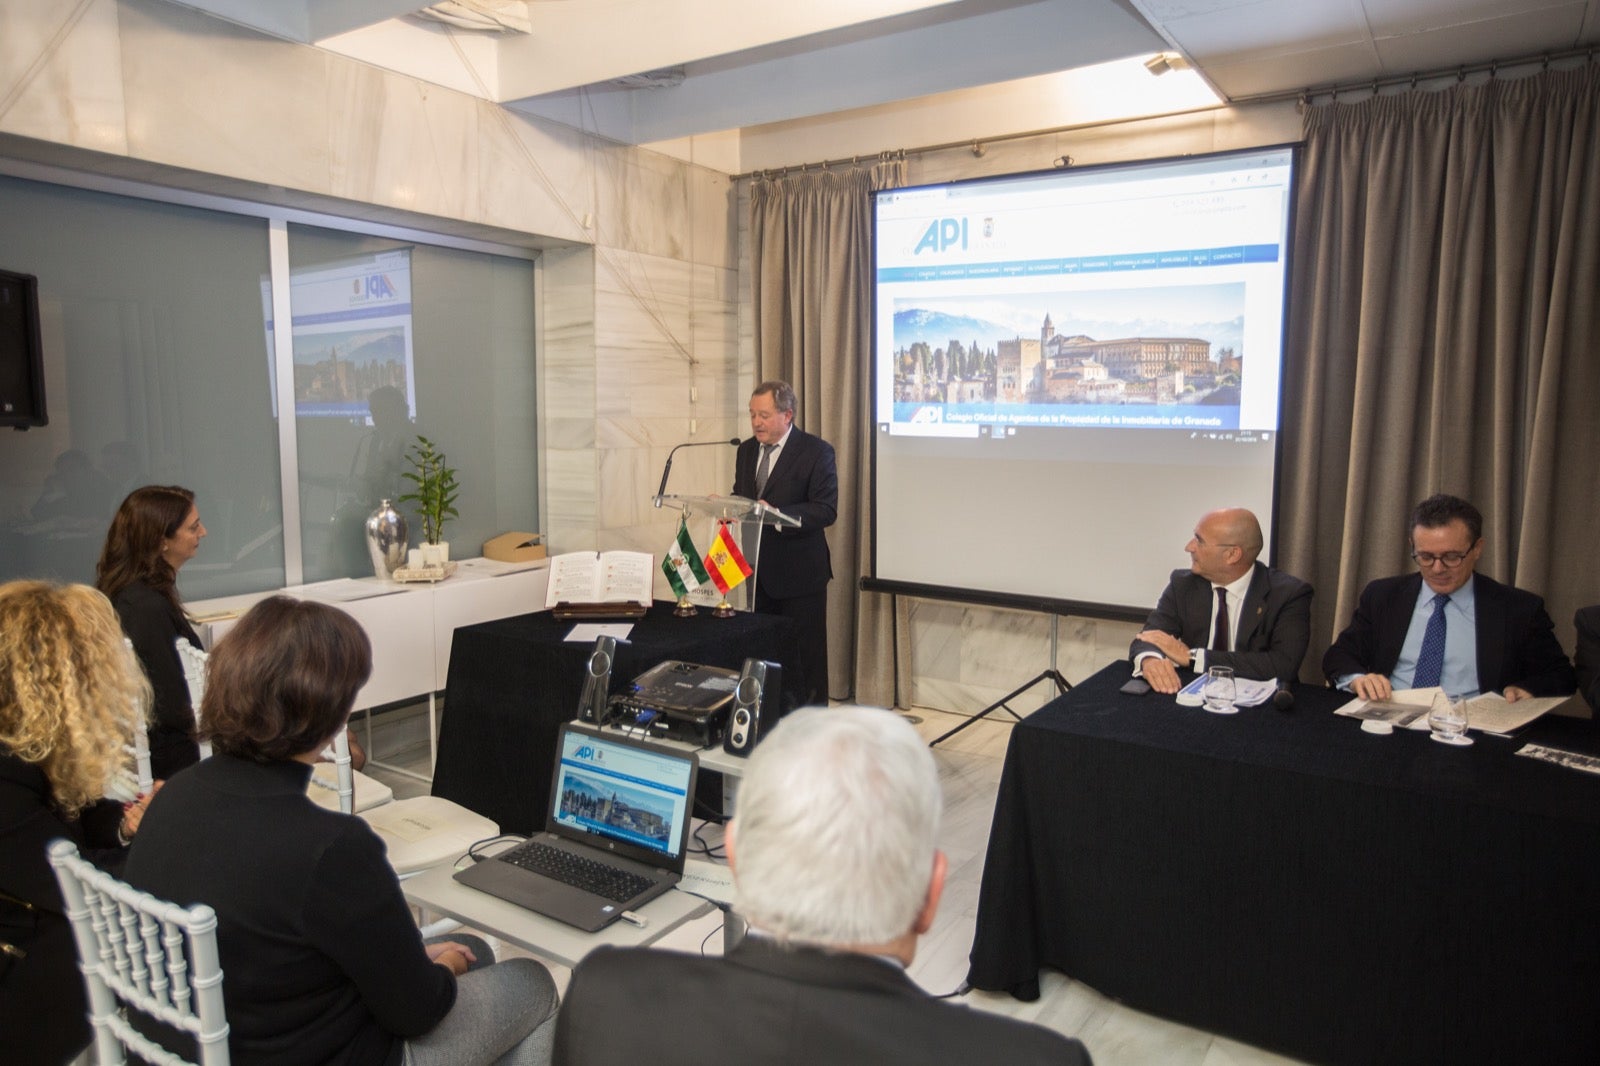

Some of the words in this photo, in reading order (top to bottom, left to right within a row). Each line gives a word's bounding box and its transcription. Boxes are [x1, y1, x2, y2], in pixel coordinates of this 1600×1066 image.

[914, 217, 968, 255] API
[946, 413, 972, 422] Colegio
[974, 413, 997, 422] Oficial
[999, 413, 1008, 422] de
[1009, 414, 1039, 424] Agentes
[1040, 414, 1050, 423] de
[1060, 414, 1100, 426] Propiedad
[1101, 415, 1111, 424] de
[1112, 415, 1121, 424] la
[1122, 415, 1170, 425] Inmobiliaria
[1172, 416, 1183, 425] de
[575, 746, 594, 760] API
